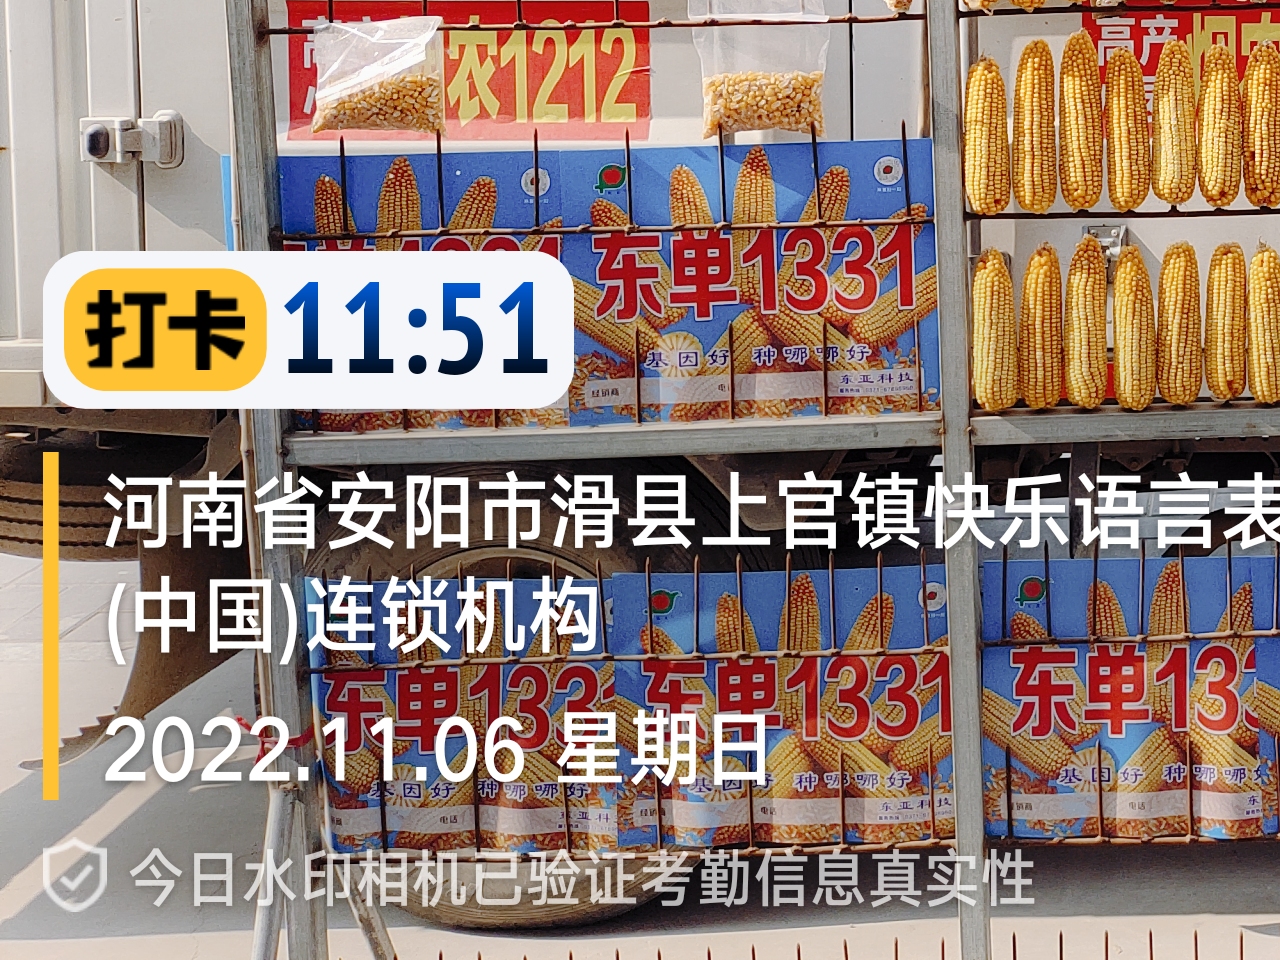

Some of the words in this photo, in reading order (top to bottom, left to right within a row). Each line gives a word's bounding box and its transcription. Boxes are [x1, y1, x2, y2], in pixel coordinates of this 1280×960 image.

[408, 15, 637, 128] 农1212
[589, 220, 919, 322] 东单1331
[645, 350, 730, 371] 基因好
[751, 344, 872, 367] 种哪哪好
[838, 372, 914, 385] 东亚科技
[324, 665, 615, 753] 东单133
[644, 658, 952, 751] 东单1331
[794, 771, 912, 793] 种哪哪好
[1058, 765, 1145, 786] 基因好
[368, 780, 456, 800] 基因好
[478, 779, 591, 801] 种哪哪好
